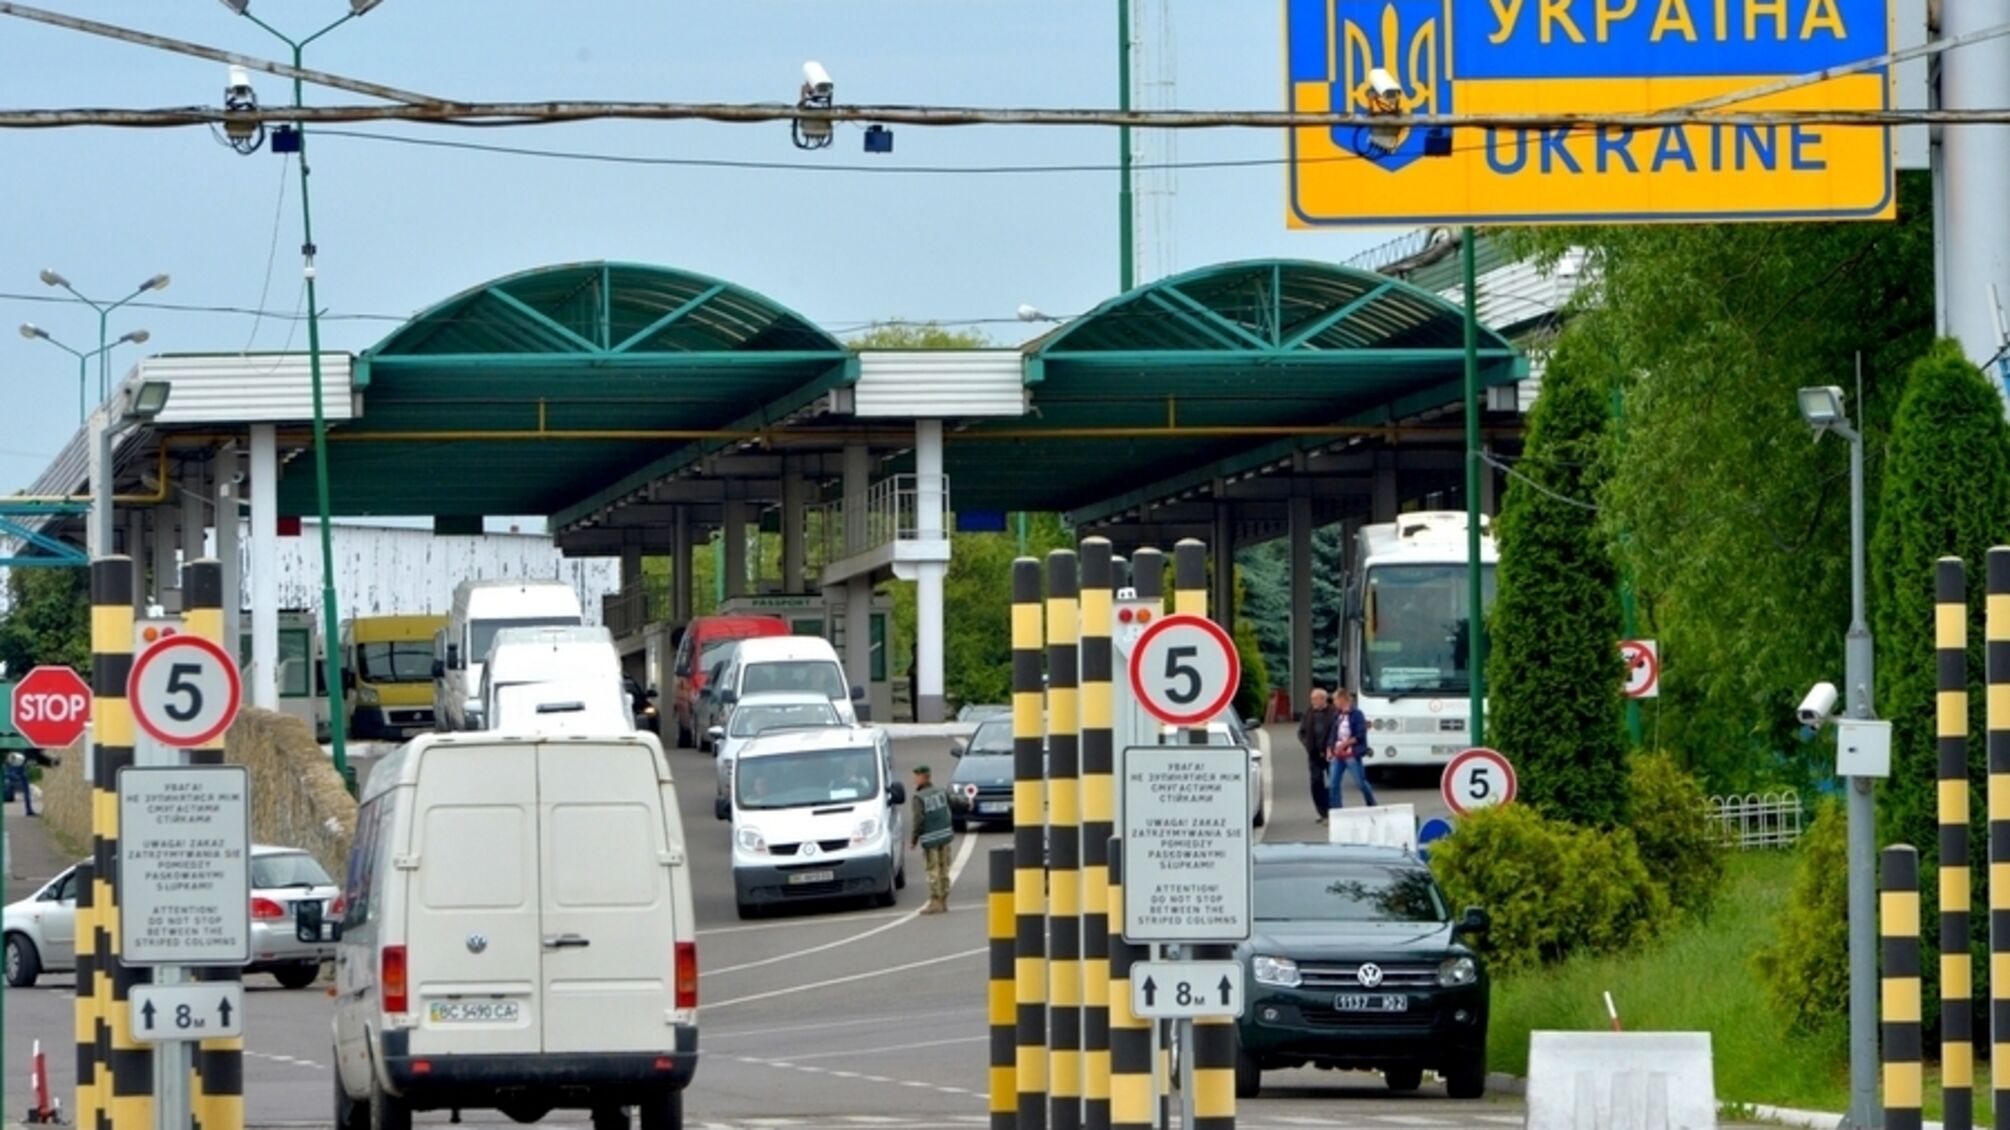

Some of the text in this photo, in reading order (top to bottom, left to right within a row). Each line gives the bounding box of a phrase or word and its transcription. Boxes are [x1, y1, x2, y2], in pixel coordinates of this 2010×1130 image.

[1485, 120, 1827, 175] UKRAINE
[751, 599, 810, 607] PASSPORT
[1164, 645, 1203, 705] 5
[164, 663, 204, 722] 5
[20, 693, 86, 721] STOP
[1131, 773, 1143, 782] НЕ
[1469, 768, 1489, 799] 5
[1192, 818, 1226, 827] ZAKAZ
[190, 839, 224, 848] ZAKAZ
[1155, 884, 1219, 893] ATTENTION!
[1150, 895, 1223, 904] DO NOT STOP
[153, 905, 218, 914] ATTENTION!
[1150, 905, 1224, 915] BETWEEN THE
[148, 915, 222, 925] DO NOT STOP
[1138, 916, 1237, 925] STRIPED COLUMNS
[147, 926, 222, 936] BETWEEN THE
[135, 937, 236, 947] STRIPED COLUMNS
